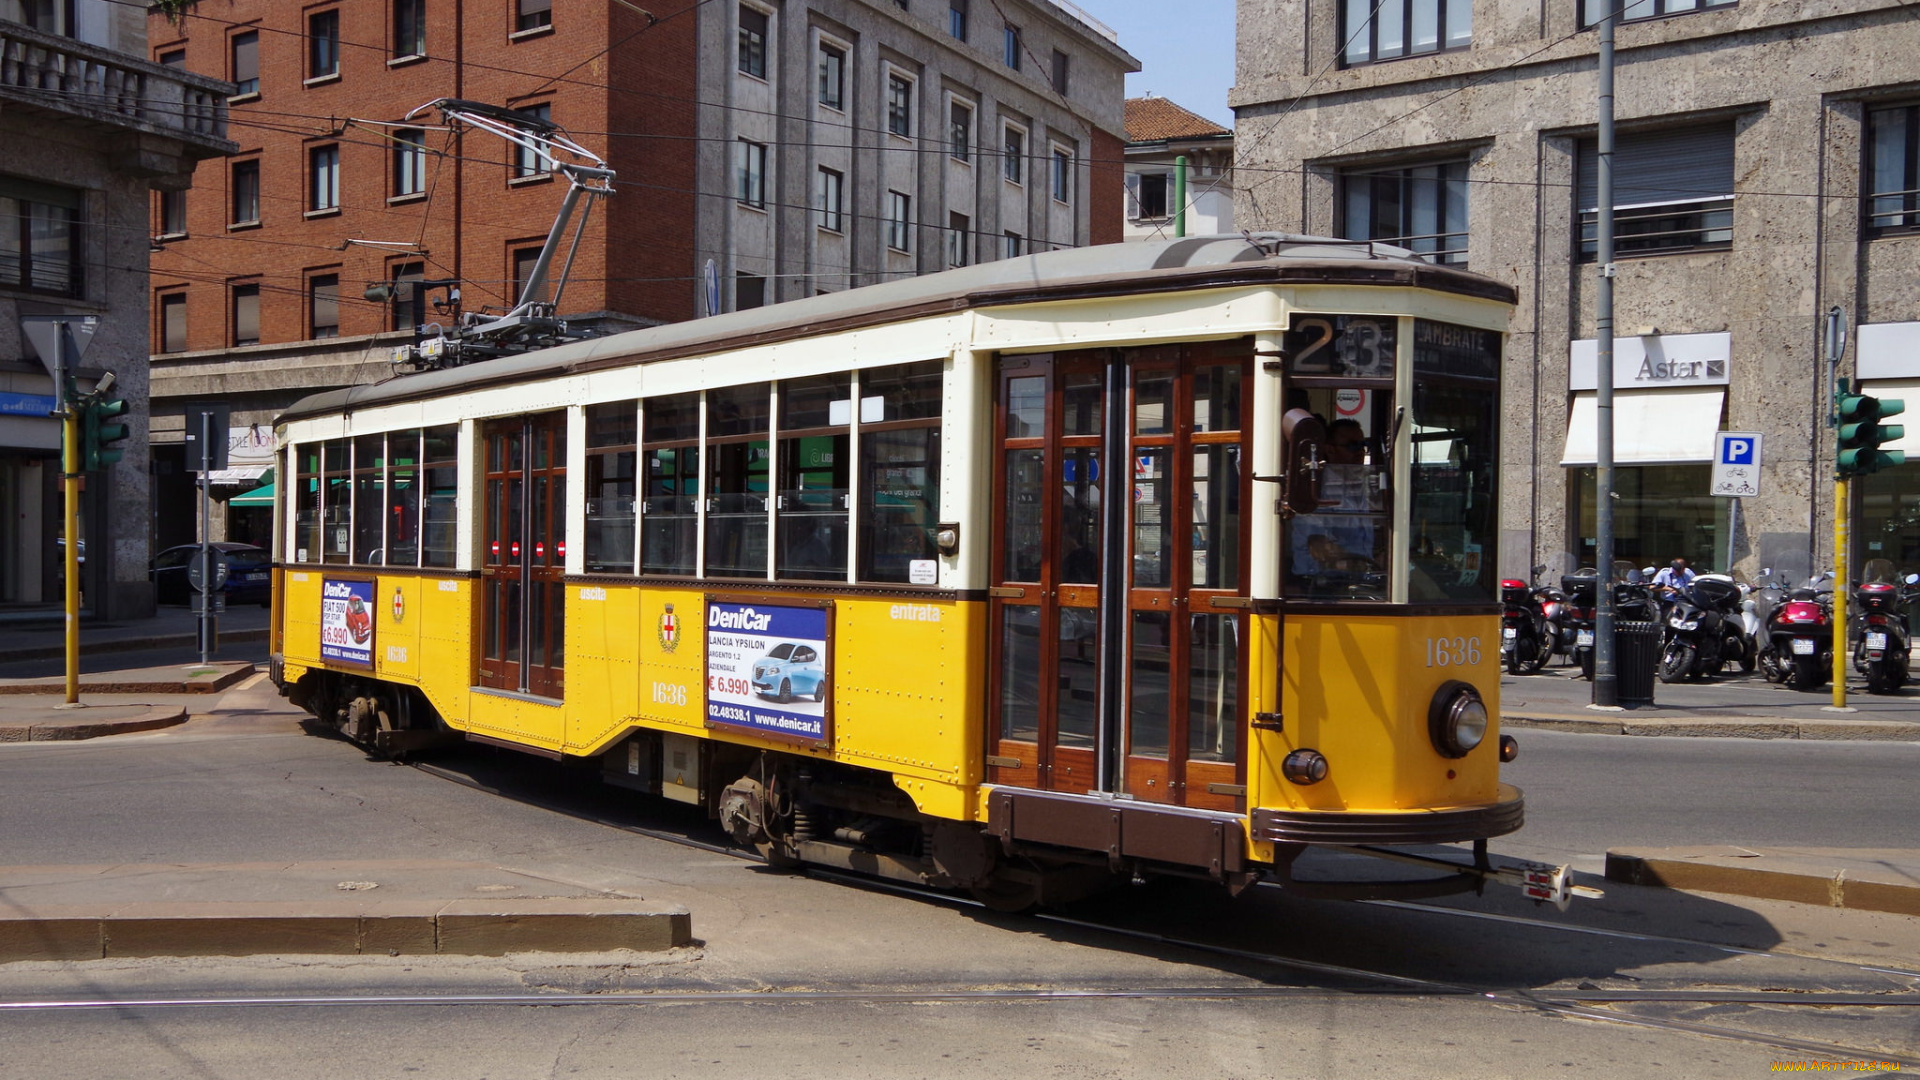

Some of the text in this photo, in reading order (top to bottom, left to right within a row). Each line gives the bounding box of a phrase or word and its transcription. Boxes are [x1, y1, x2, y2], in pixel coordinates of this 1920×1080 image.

[1635, 353, 1702, 380] Aster
[1728, 440, 1749, 461] P
[323, 582, 351, 598] DeniCar
[580, 586, 607, 601] uscita
[323, 601, 346, 614] FIAT 500
[890, 603, 941, 622] entrata
[708, 605, 772, 632] DeniCar
[708, 636, 765, 650] LANCIA YPSILON
[1425, 636, 1482, 668] 1636
[388, 647, 407, 663] 1636
[708, 650, 741, 661] ARGENTO 1.2
[708, 662, 736, 673] AZIENDALE
[652, 681, 688, 707] 1636
[717, 676, 749, 696] 6.990
[708, 704, 821, 734] 02.48338.1 www.denicar.it
